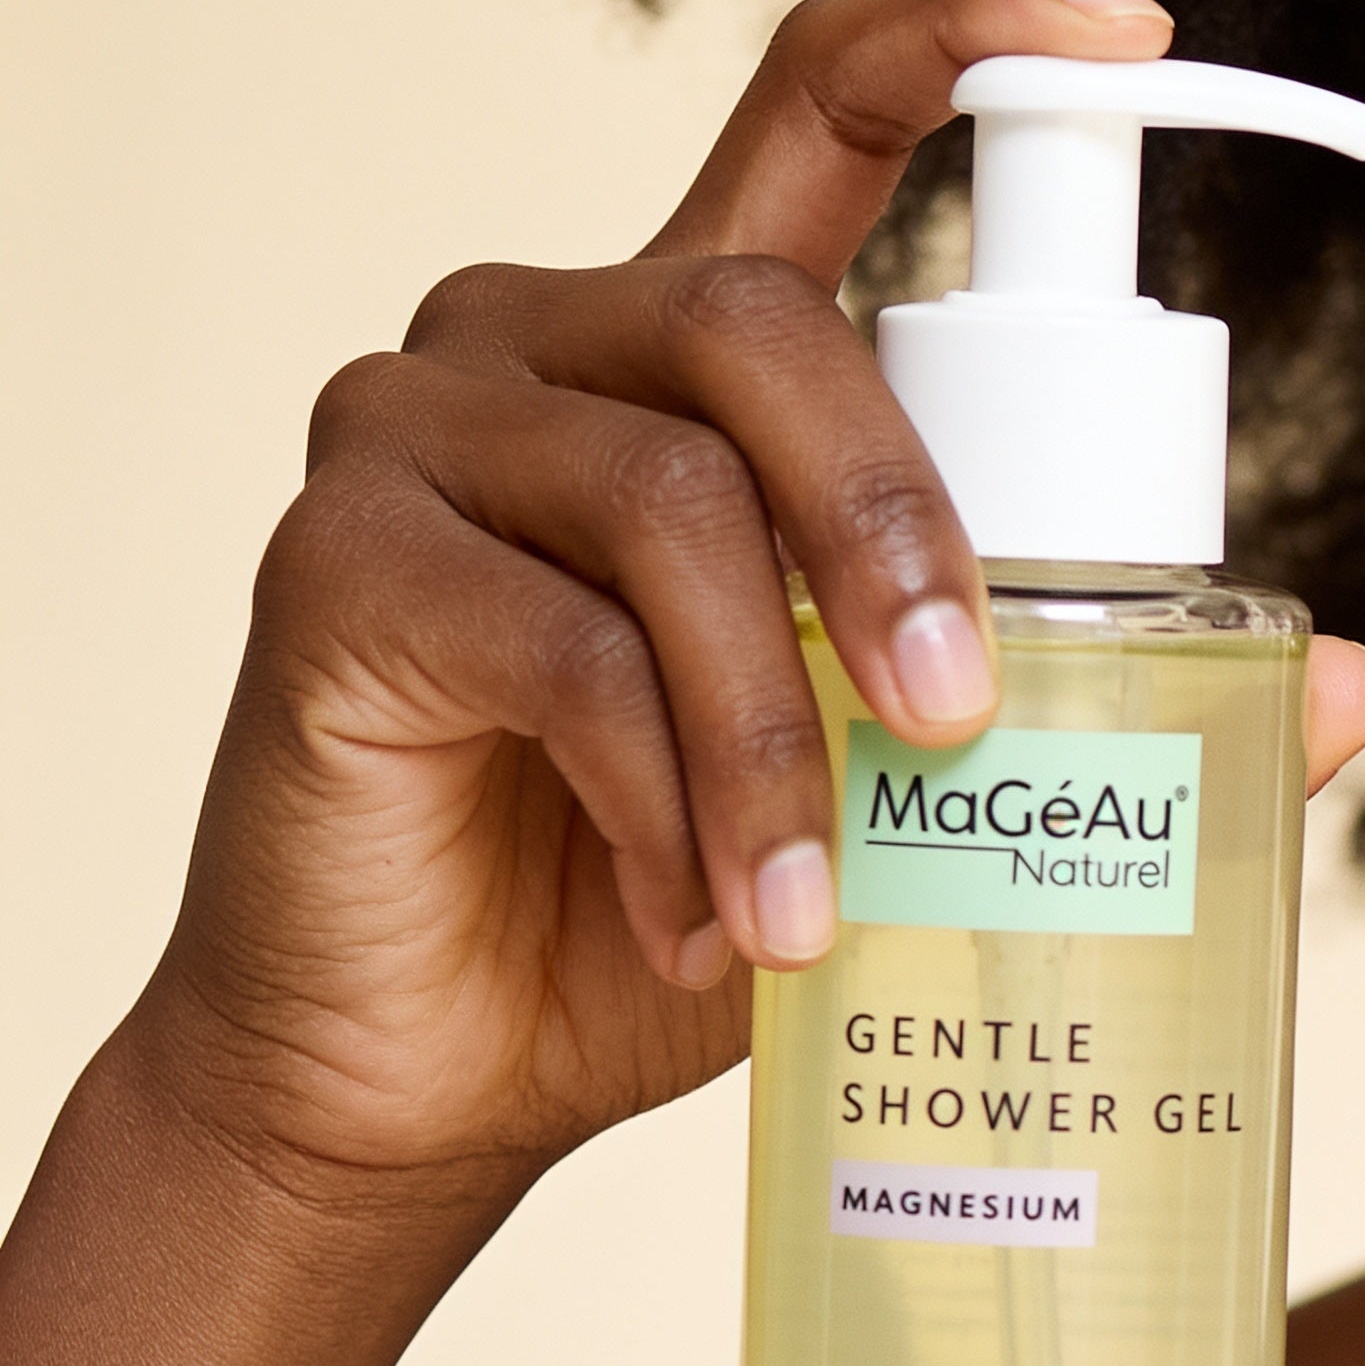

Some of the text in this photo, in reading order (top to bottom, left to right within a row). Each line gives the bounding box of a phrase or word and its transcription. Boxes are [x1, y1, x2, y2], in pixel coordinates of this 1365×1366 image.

[1011, 848, 1170, 889] Naturel
[845, 1013, 1093, 1063] GENTLE
[841, 1082, 1243, 1134] SHOWER GEL
[841, 1185, 1081, 1222] MAGNESIUM
